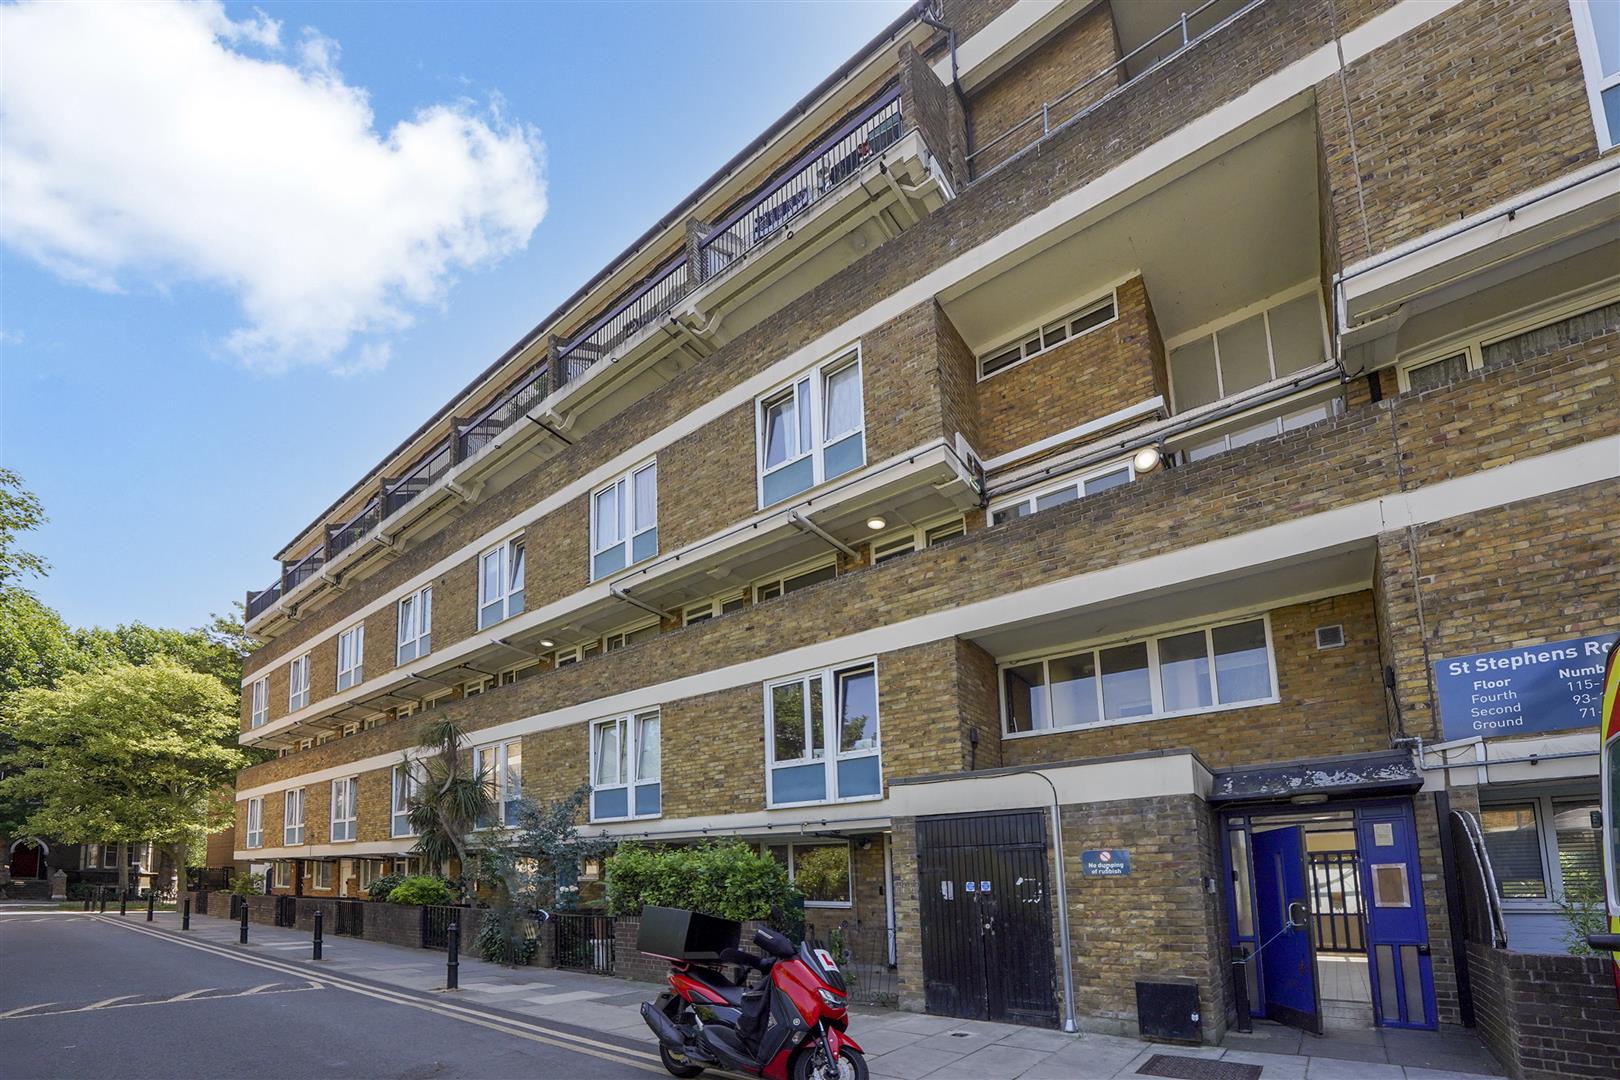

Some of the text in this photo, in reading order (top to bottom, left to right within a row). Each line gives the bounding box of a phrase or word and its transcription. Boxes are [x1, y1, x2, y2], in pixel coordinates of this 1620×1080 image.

[1449, 662, 1470, 676] St
[1475, 647, 1578, 671] Stephens
[1473, 678, 1511, 690] Floor
[1471, 690, 1517, 704] Fourth
[1471, 703, 1521, 718] Second
[1473, 716, 1523, 731] Ground
[820, 953, 834, 966] L
